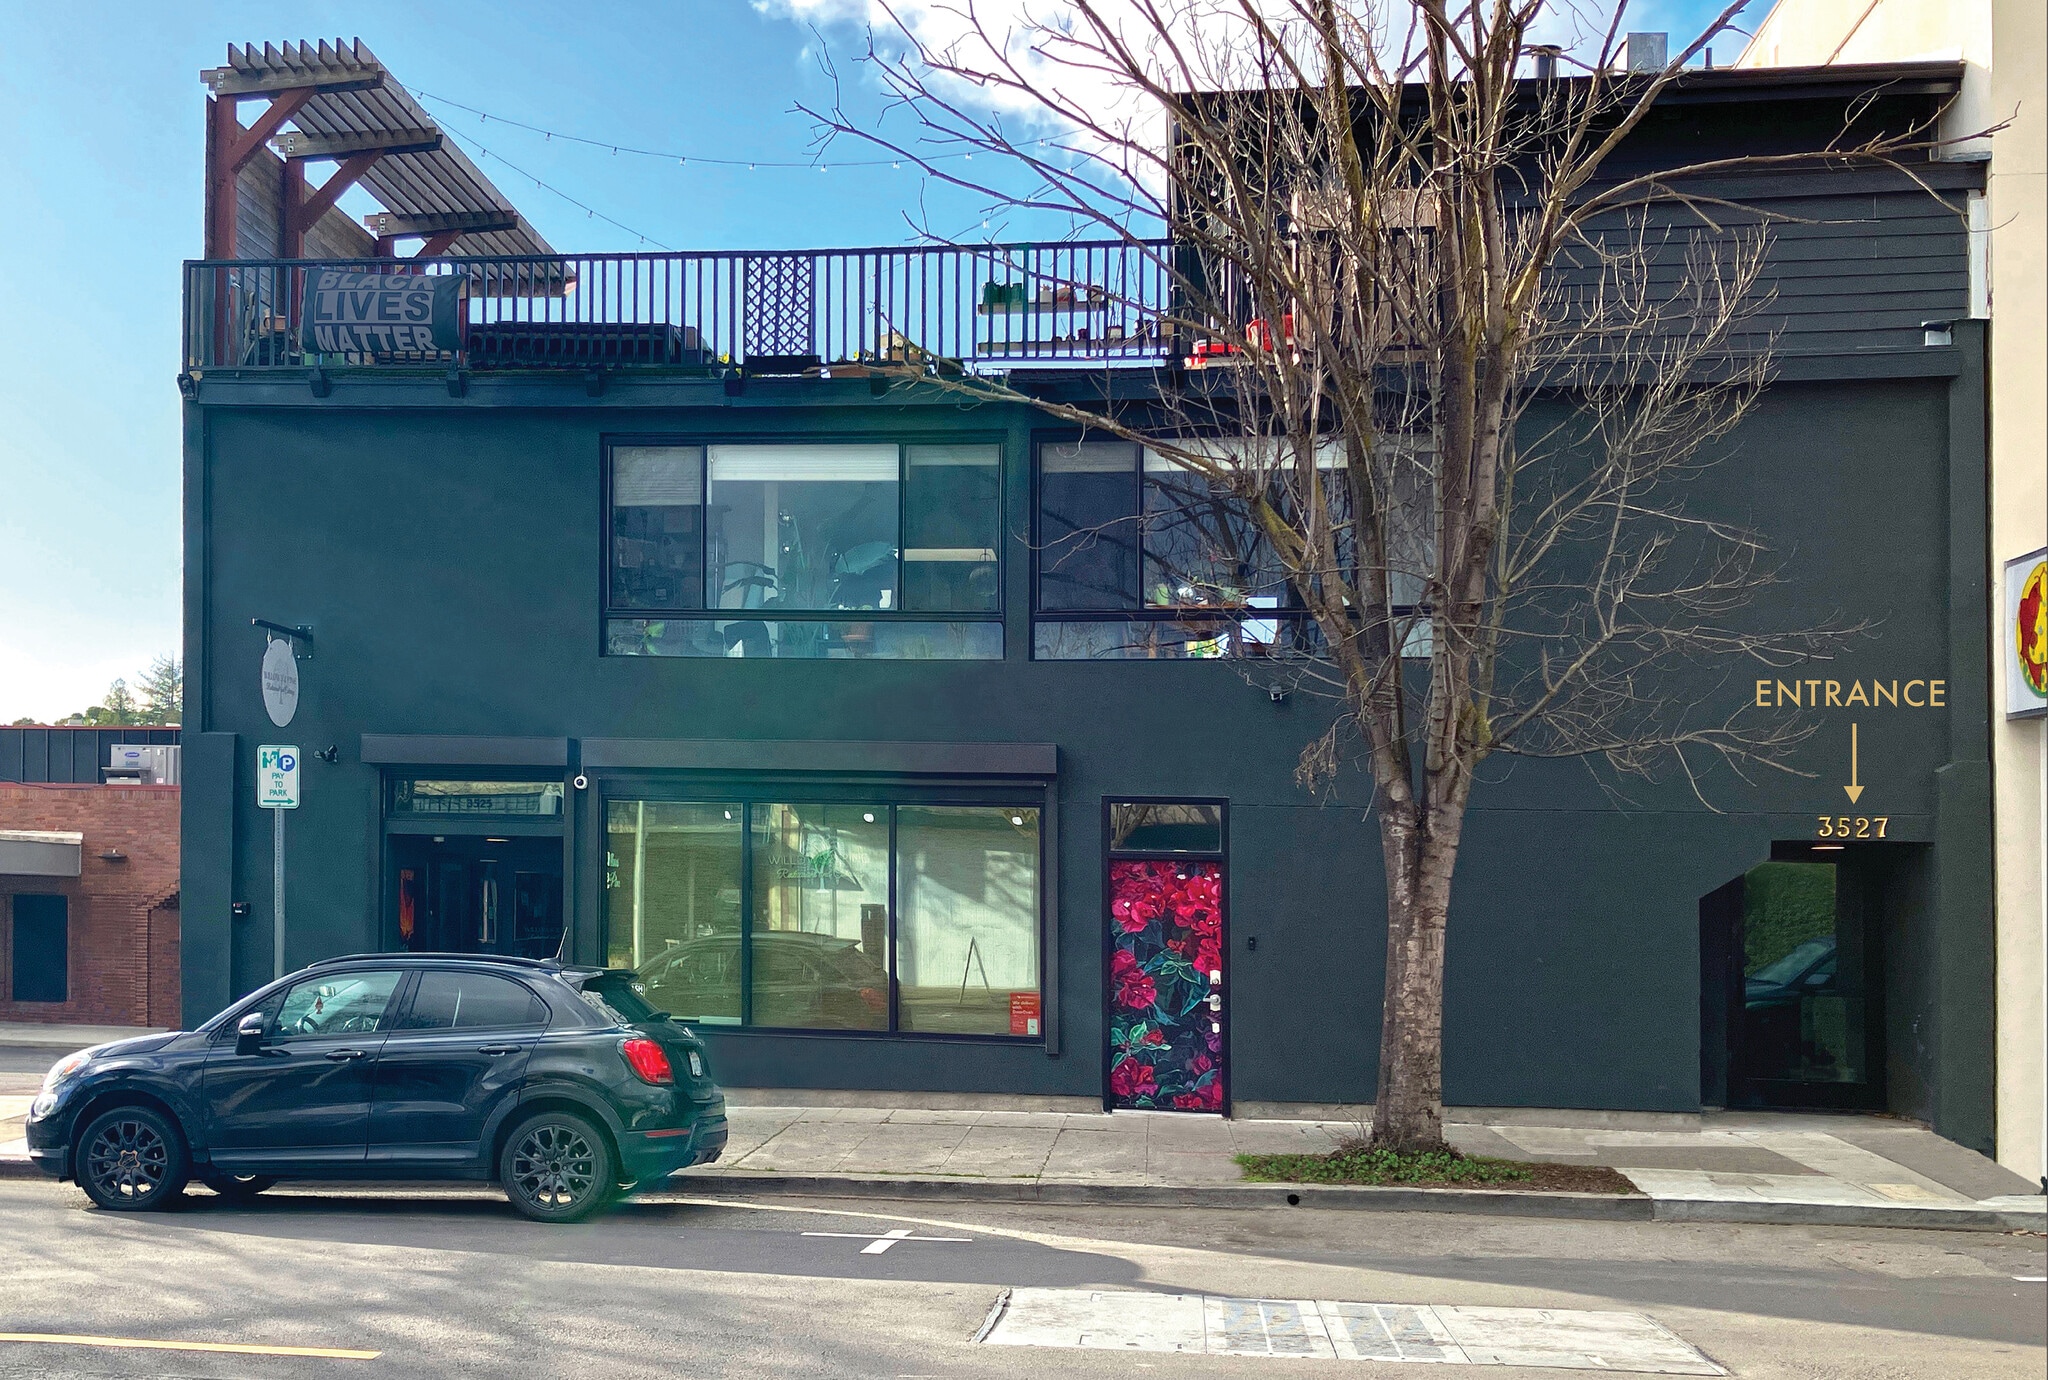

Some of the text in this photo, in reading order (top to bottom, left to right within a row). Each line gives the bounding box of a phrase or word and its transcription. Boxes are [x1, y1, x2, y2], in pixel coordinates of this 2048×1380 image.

[317, 272, 435, 290] BLACK
[315, 291, 430, 321] LIVES
[314, 325, 439, 352] MATTER
[271, 772, 285, 780] PAY
[274, 780, 284, 789] TO
[269, 789, 288, 797] PARK
[1818, 816, 1889, 839] 3527
